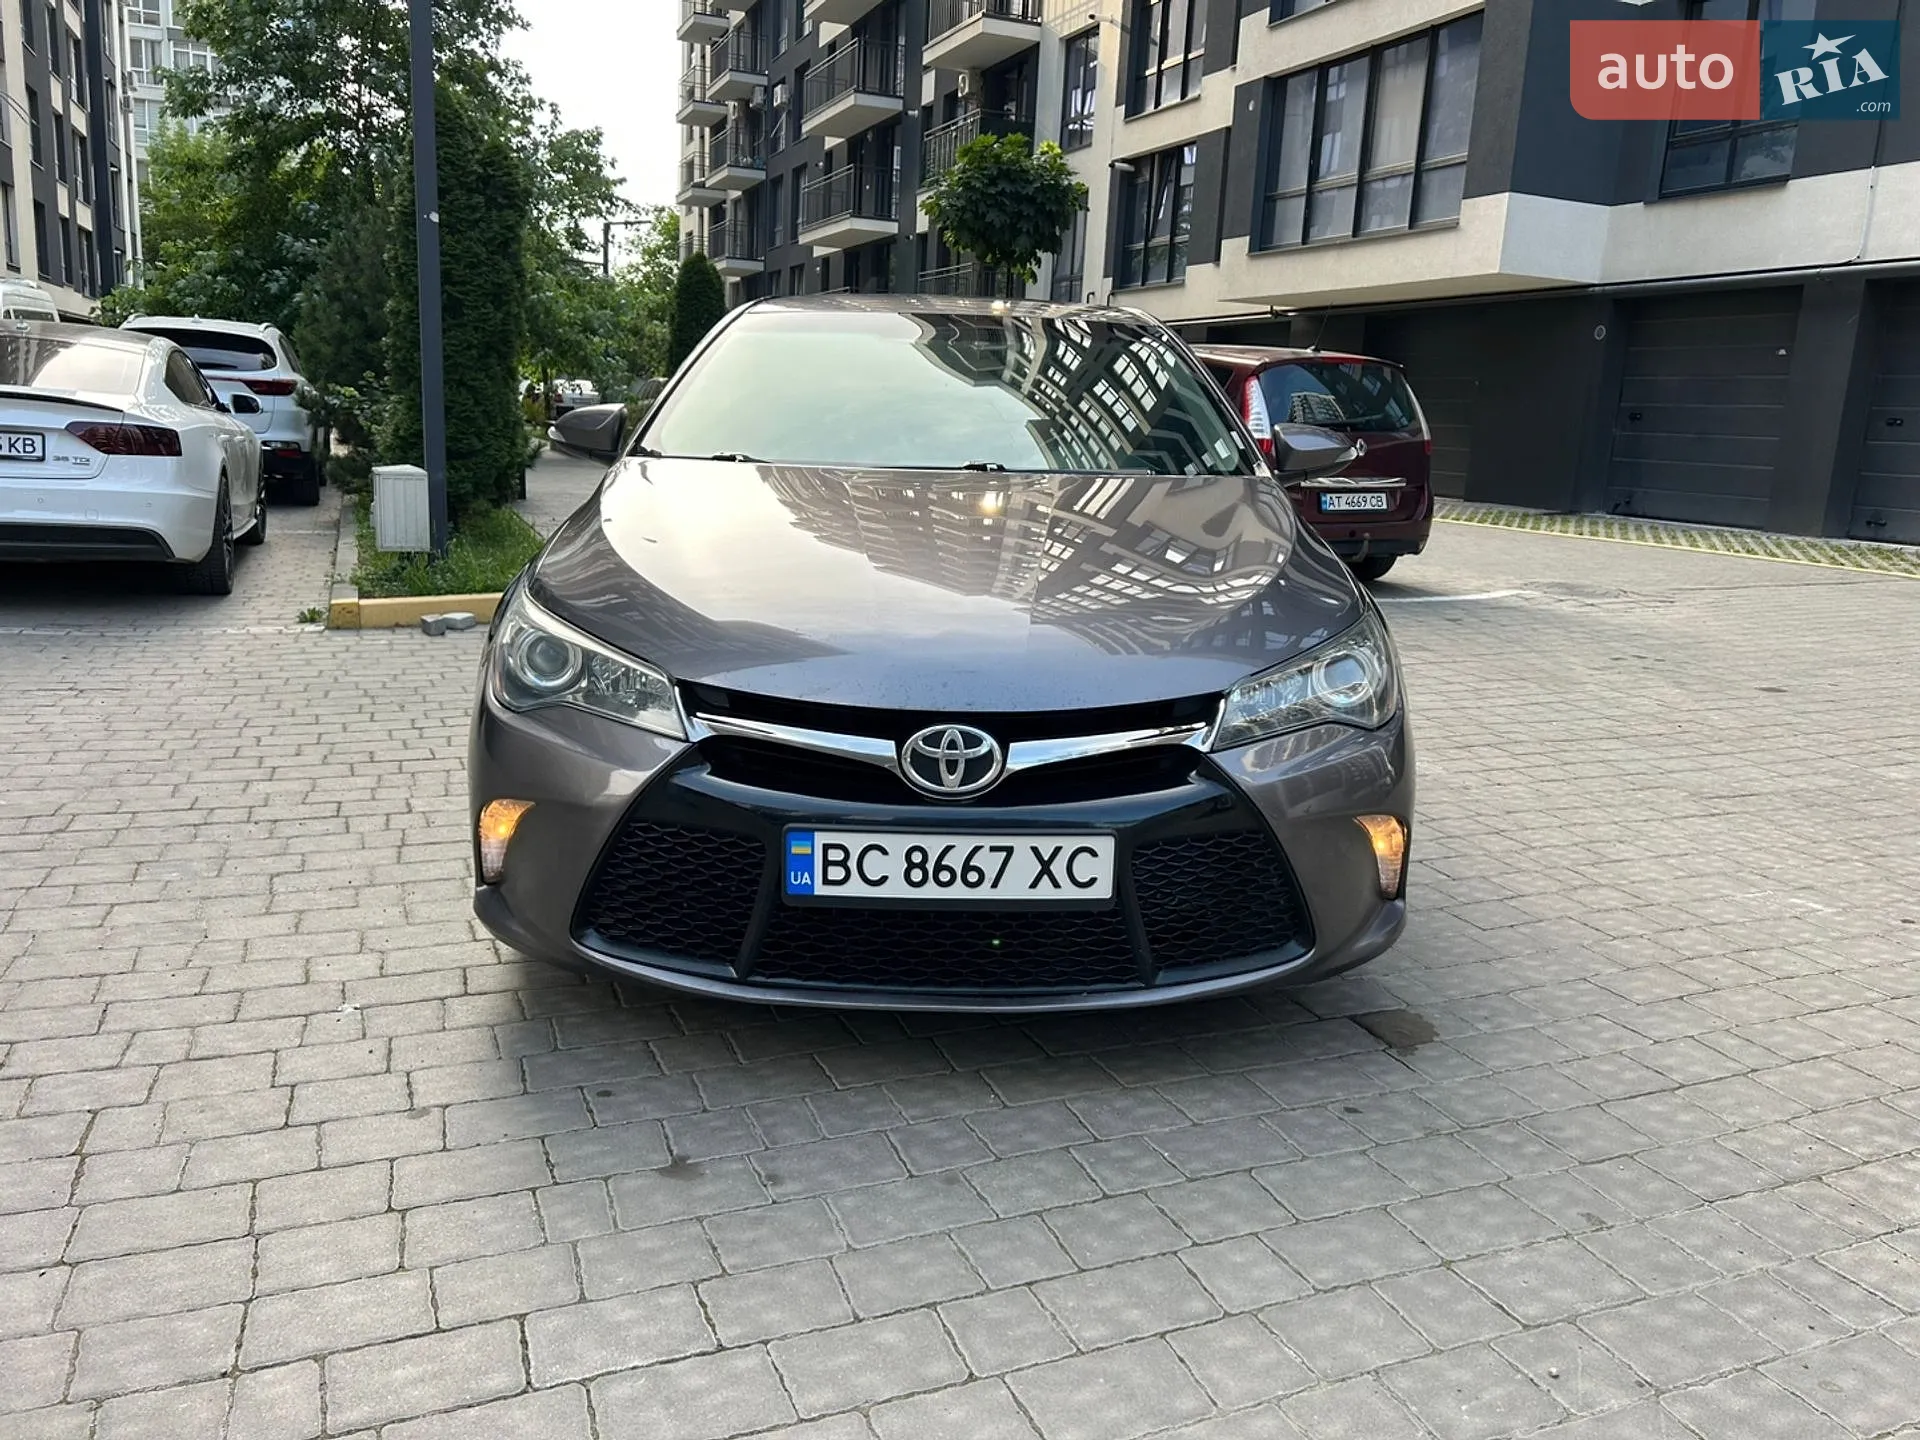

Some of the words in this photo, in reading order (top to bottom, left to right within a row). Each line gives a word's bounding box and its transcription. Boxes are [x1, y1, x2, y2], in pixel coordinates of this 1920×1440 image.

[8, 437, 36, 454] KB
[1328, 495, 1343, 508] AT
[1345, 495, 1368, 508] 4669
[1370, 495, 1384, 508] CB
[821, 843, 890, 887] BC
[903, 845, 1015, 888] 8667
[1028, 845, 1100, 888] XC
[791, 872, 811, 886] UA
